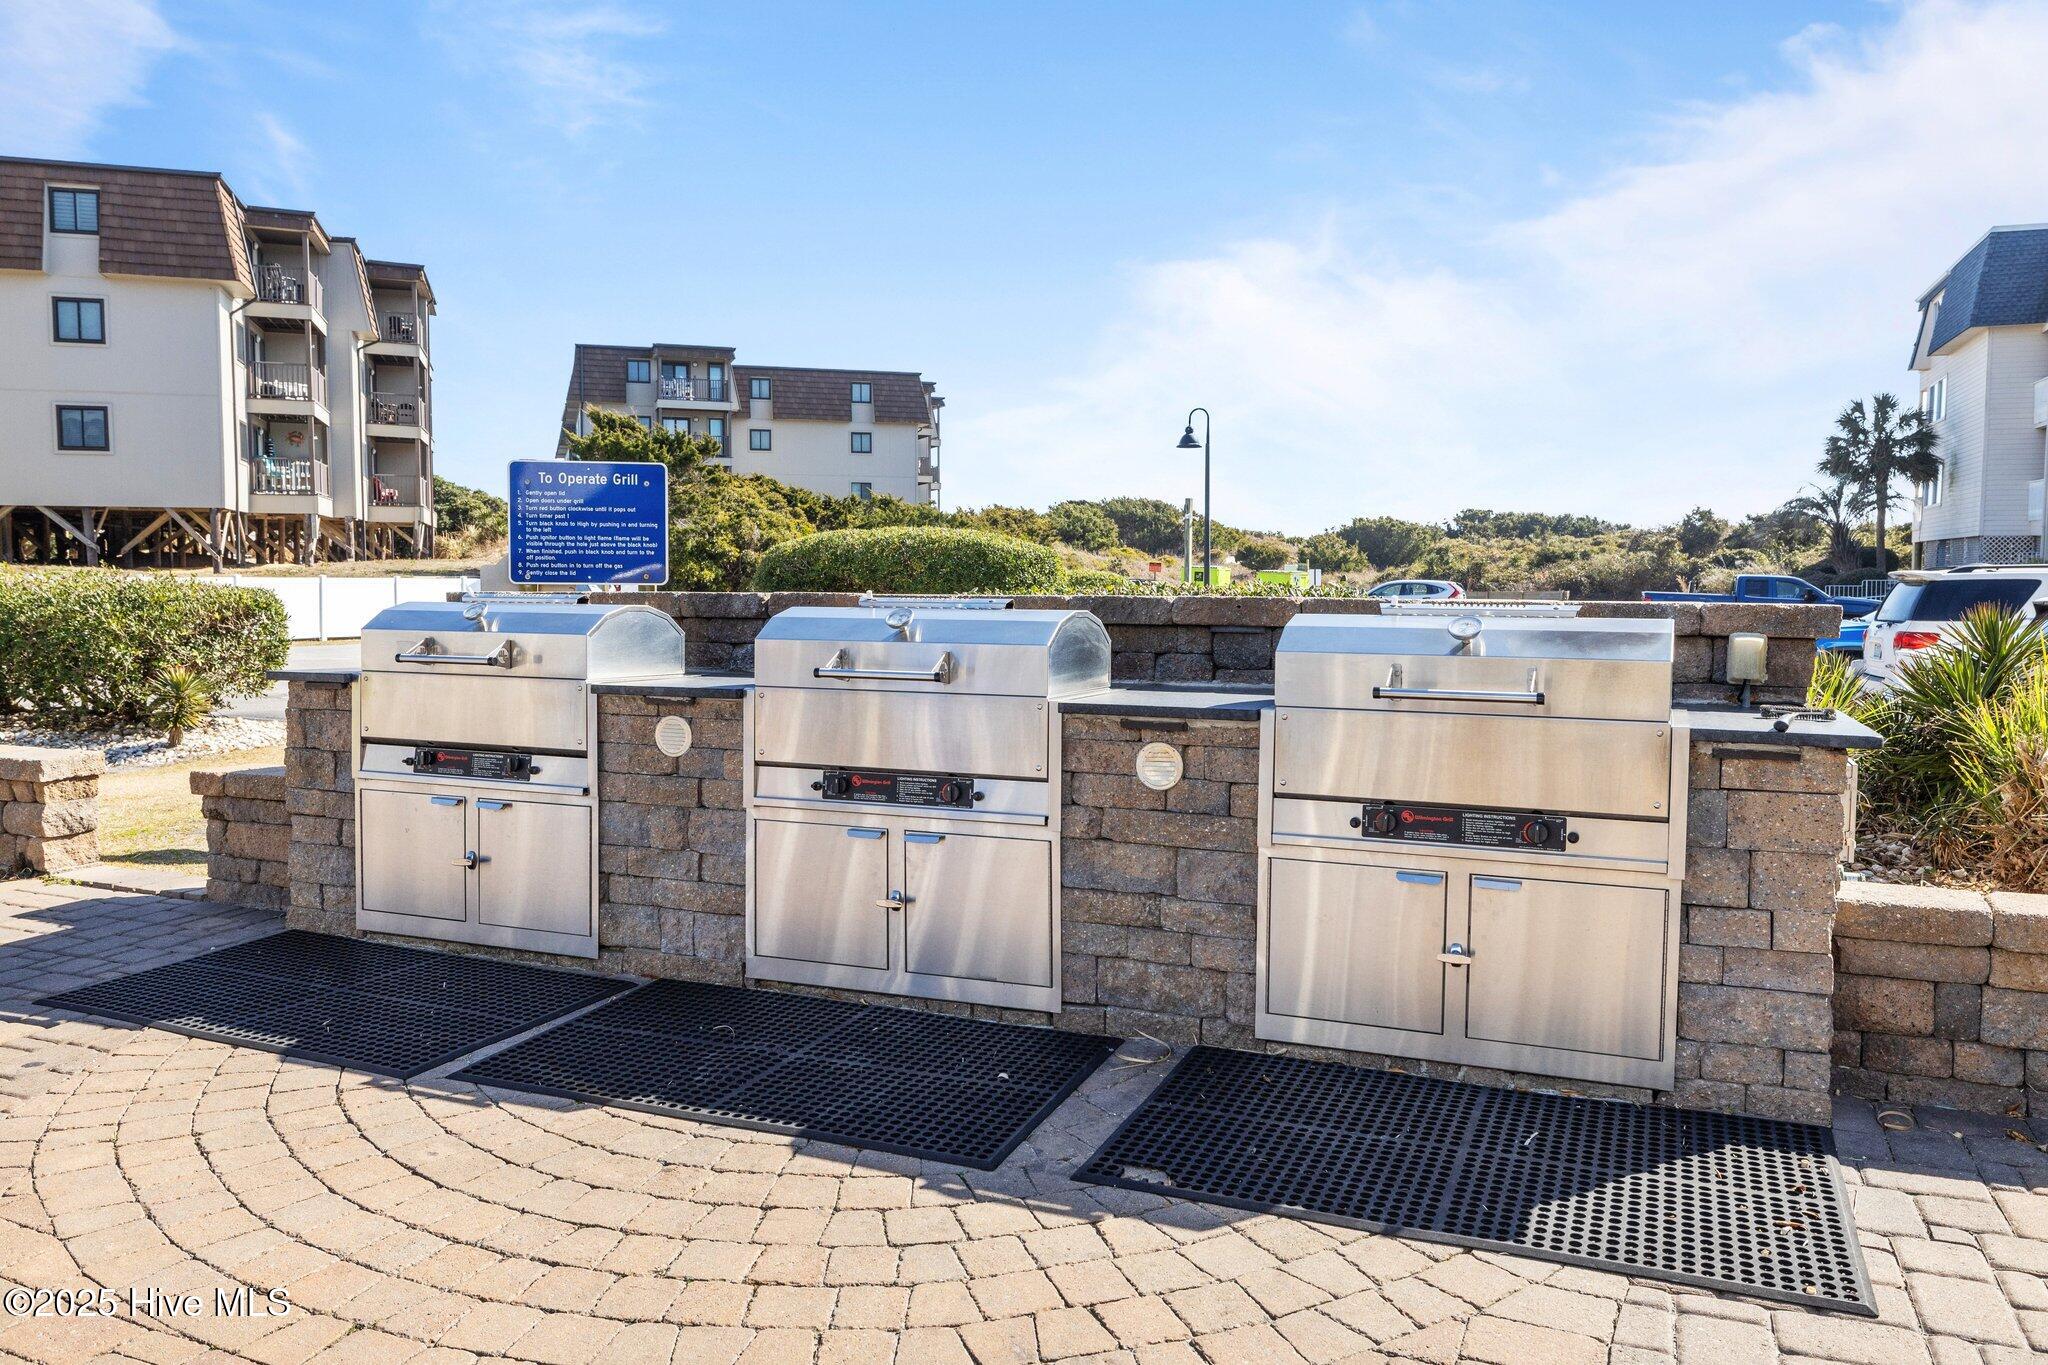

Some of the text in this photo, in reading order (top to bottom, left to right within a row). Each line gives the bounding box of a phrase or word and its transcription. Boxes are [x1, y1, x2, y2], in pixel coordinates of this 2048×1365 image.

[538, 472, 638, 486] To Operate Grill
